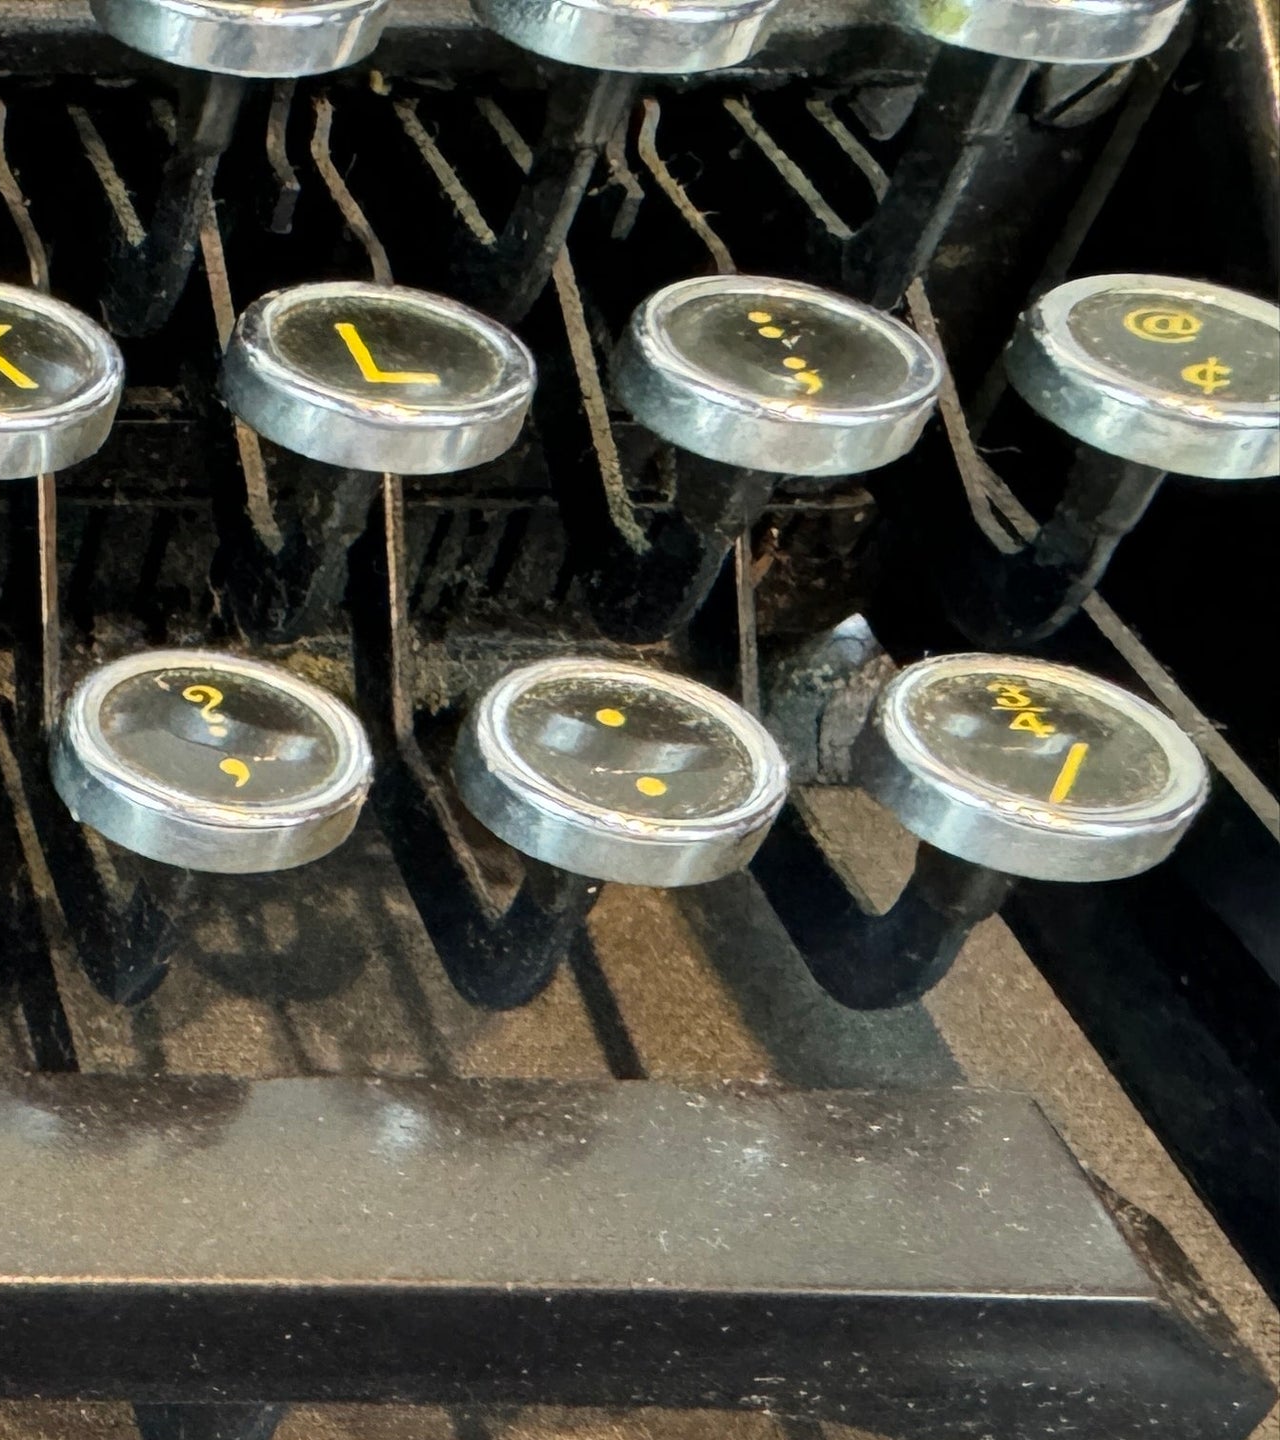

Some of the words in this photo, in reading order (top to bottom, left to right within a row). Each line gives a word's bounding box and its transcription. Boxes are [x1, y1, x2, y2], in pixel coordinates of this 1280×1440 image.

[1122, 306, 1203, 344] @
[333, 321, 439, 385] L
[181, 684, 229, 739] ?
